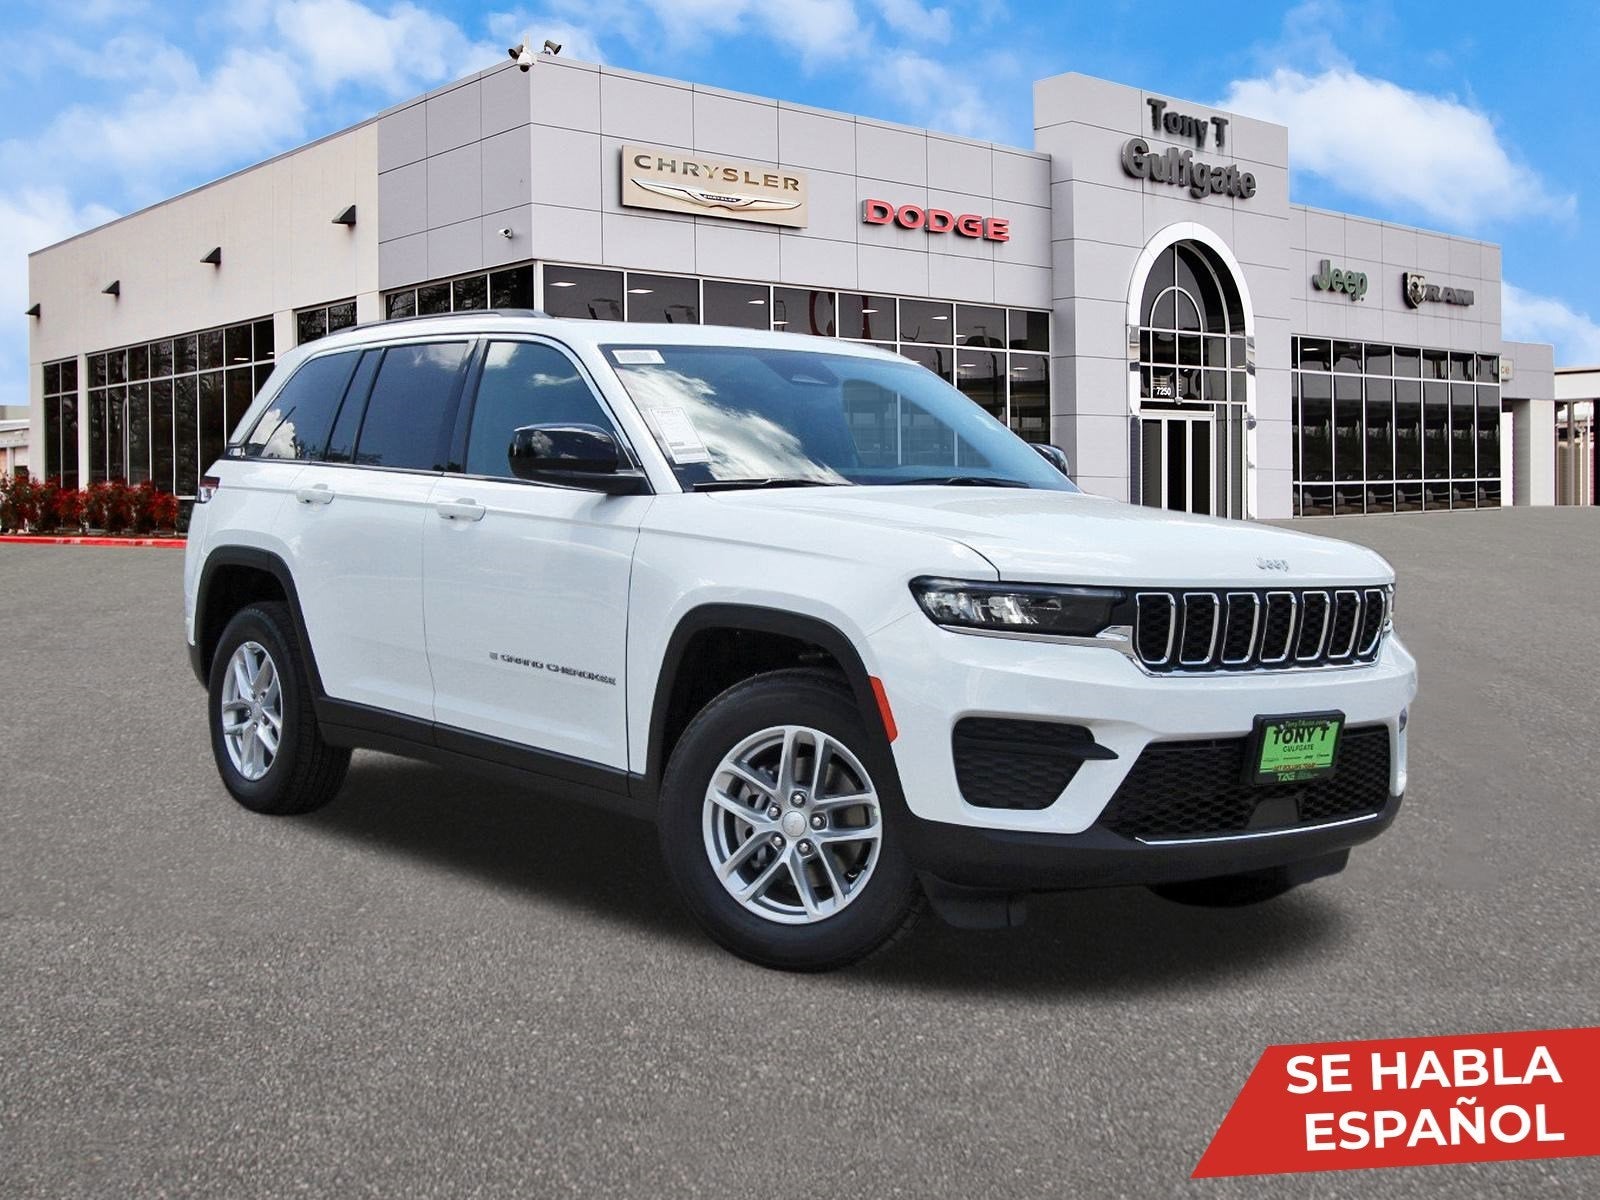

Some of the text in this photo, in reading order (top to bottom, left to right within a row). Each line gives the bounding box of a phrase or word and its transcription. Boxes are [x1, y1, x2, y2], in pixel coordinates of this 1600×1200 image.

[1146, 98, 1229, 148] Tony T
[633, 154, 800, 192] CHRYSLER
[1120, 138, 1257, 199] Gulfgate
[862, 198, 1010, 243] DODGE
[1312, 259, 1368, 302] Jeep
[1425, 284, 1475, 306] RAM
[1273, 725, 1330, 745] TONY T
